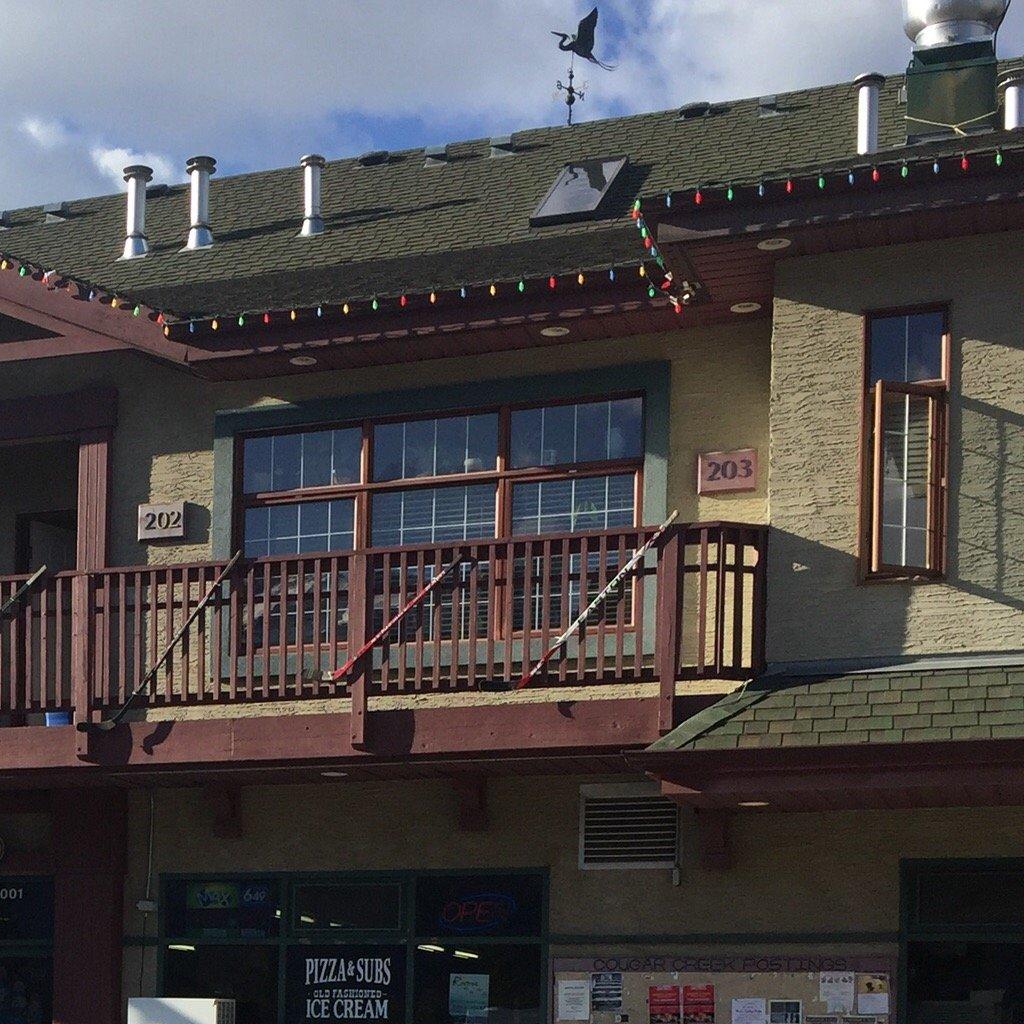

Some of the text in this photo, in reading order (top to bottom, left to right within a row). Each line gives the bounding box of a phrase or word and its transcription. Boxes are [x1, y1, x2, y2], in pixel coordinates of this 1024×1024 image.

[706, 458, 753, 482] 203
[144, 510, 182, 531] 202
[305, 957, 391, 986] PIZZA & SUBS
[593, 958, 666, 971] COUGAR
[313, 989, 382, 999] OLD FASHIONED
[306, 999, 388, 1019] ICE CREAM
